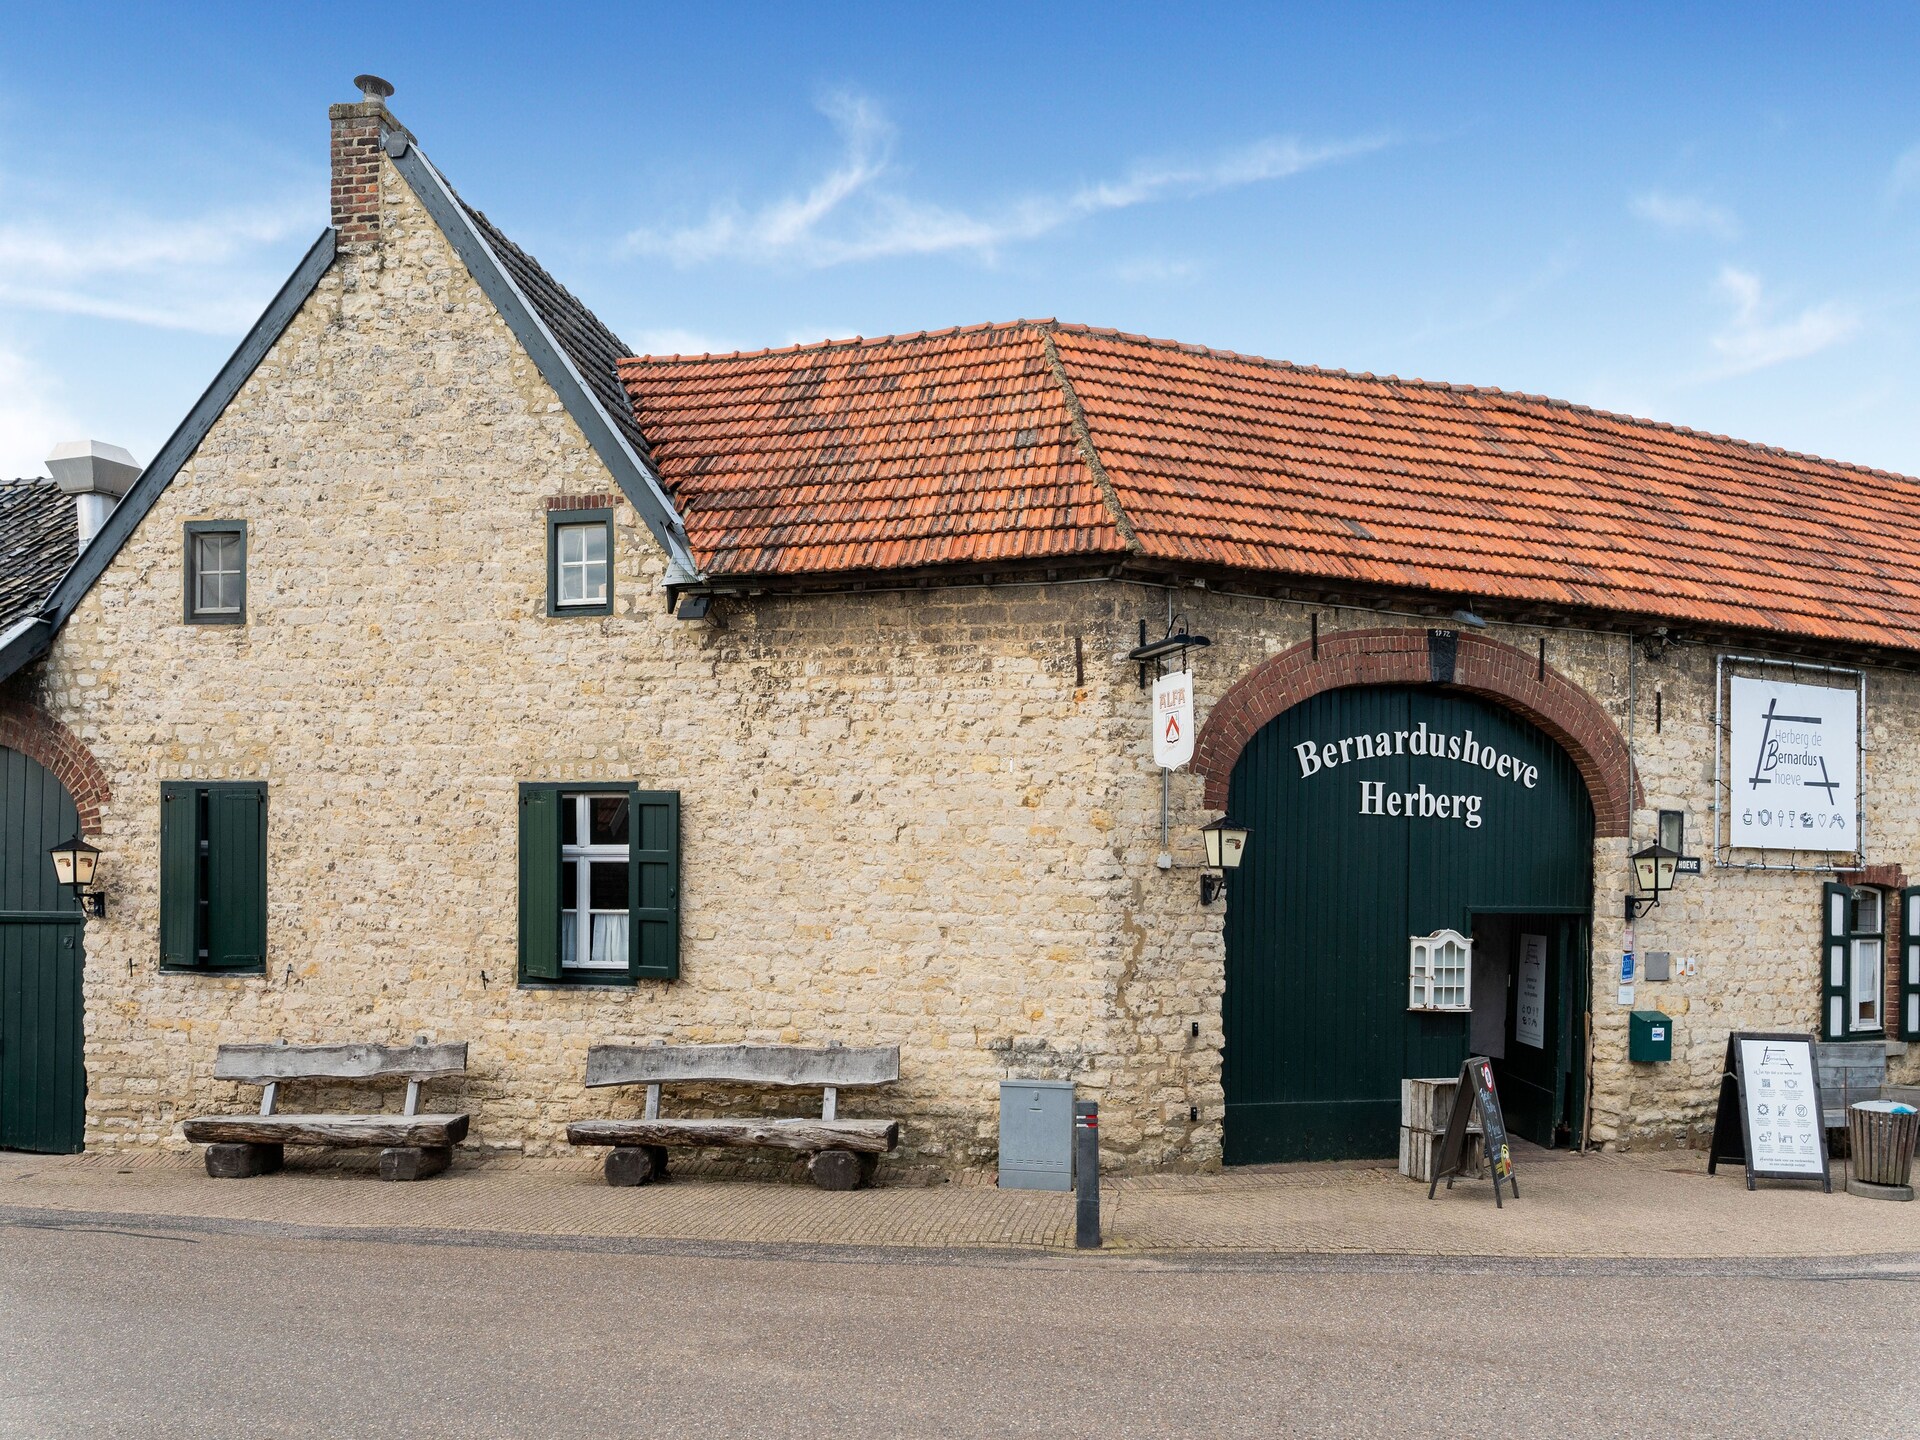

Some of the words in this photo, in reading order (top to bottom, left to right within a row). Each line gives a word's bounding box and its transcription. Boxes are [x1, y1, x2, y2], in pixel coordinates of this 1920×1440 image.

[1159, 687, 1186, 710] ALFA
[1775, 729, 1809, 749] Herberg
[1811, 731, 1822, 747] de
[1293, 722, 1539, 789] Bernardushoeve
[1763, 739, 1818, 771] Bernardus
[1775, 769, 1801, 786] hoeve
[1359, 780, 1482, 829] Herberg
[1678, 860, 1698, 870] HOEVE
